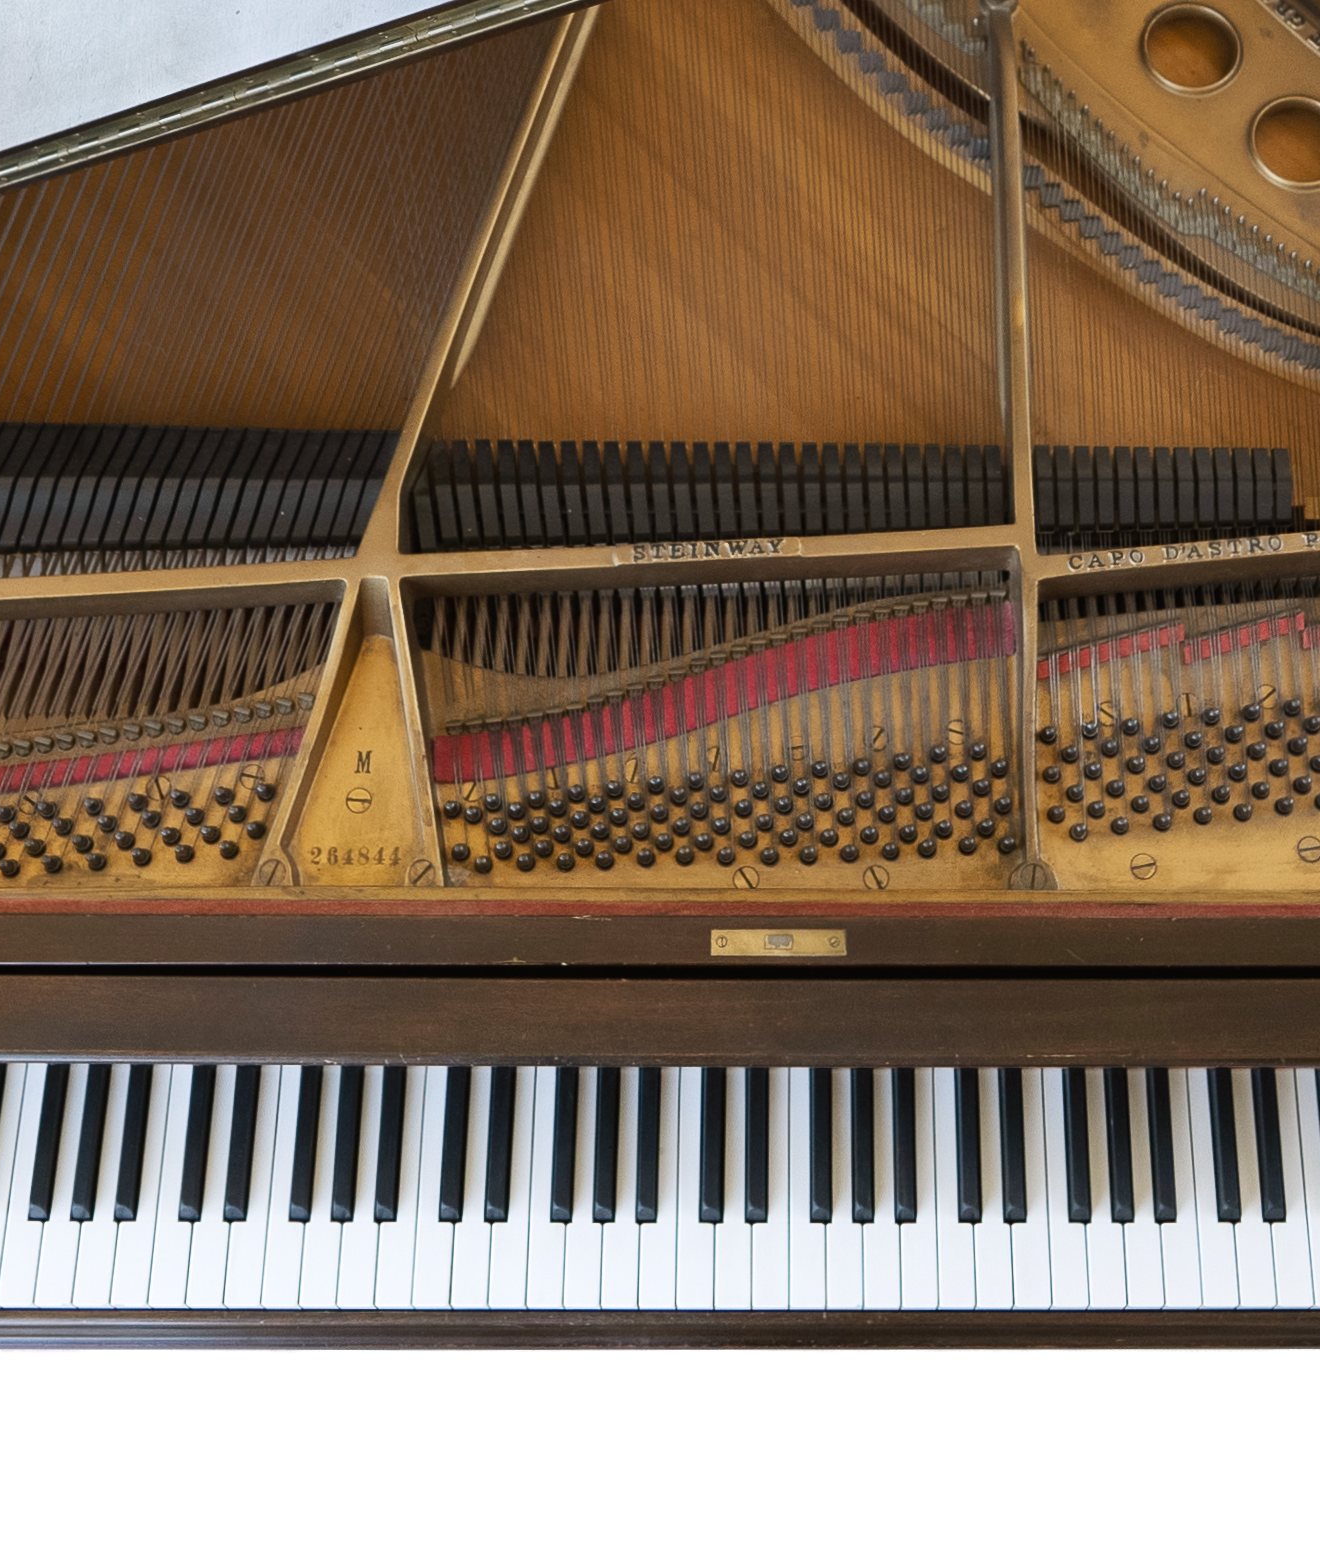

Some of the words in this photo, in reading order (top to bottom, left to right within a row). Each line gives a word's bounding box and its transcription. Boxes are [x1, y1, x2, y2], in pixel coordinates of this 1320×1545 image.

[1263, 0, 1305, 30] GR
[632, 538, 784, 563] STEINWAY
[1067, 549, 1146, 572] CAPO
[1163, 534, 1284, 563] D'ASTRO
[354, 750, 372, 774] M
[308, 846, 402, 866] 264844
